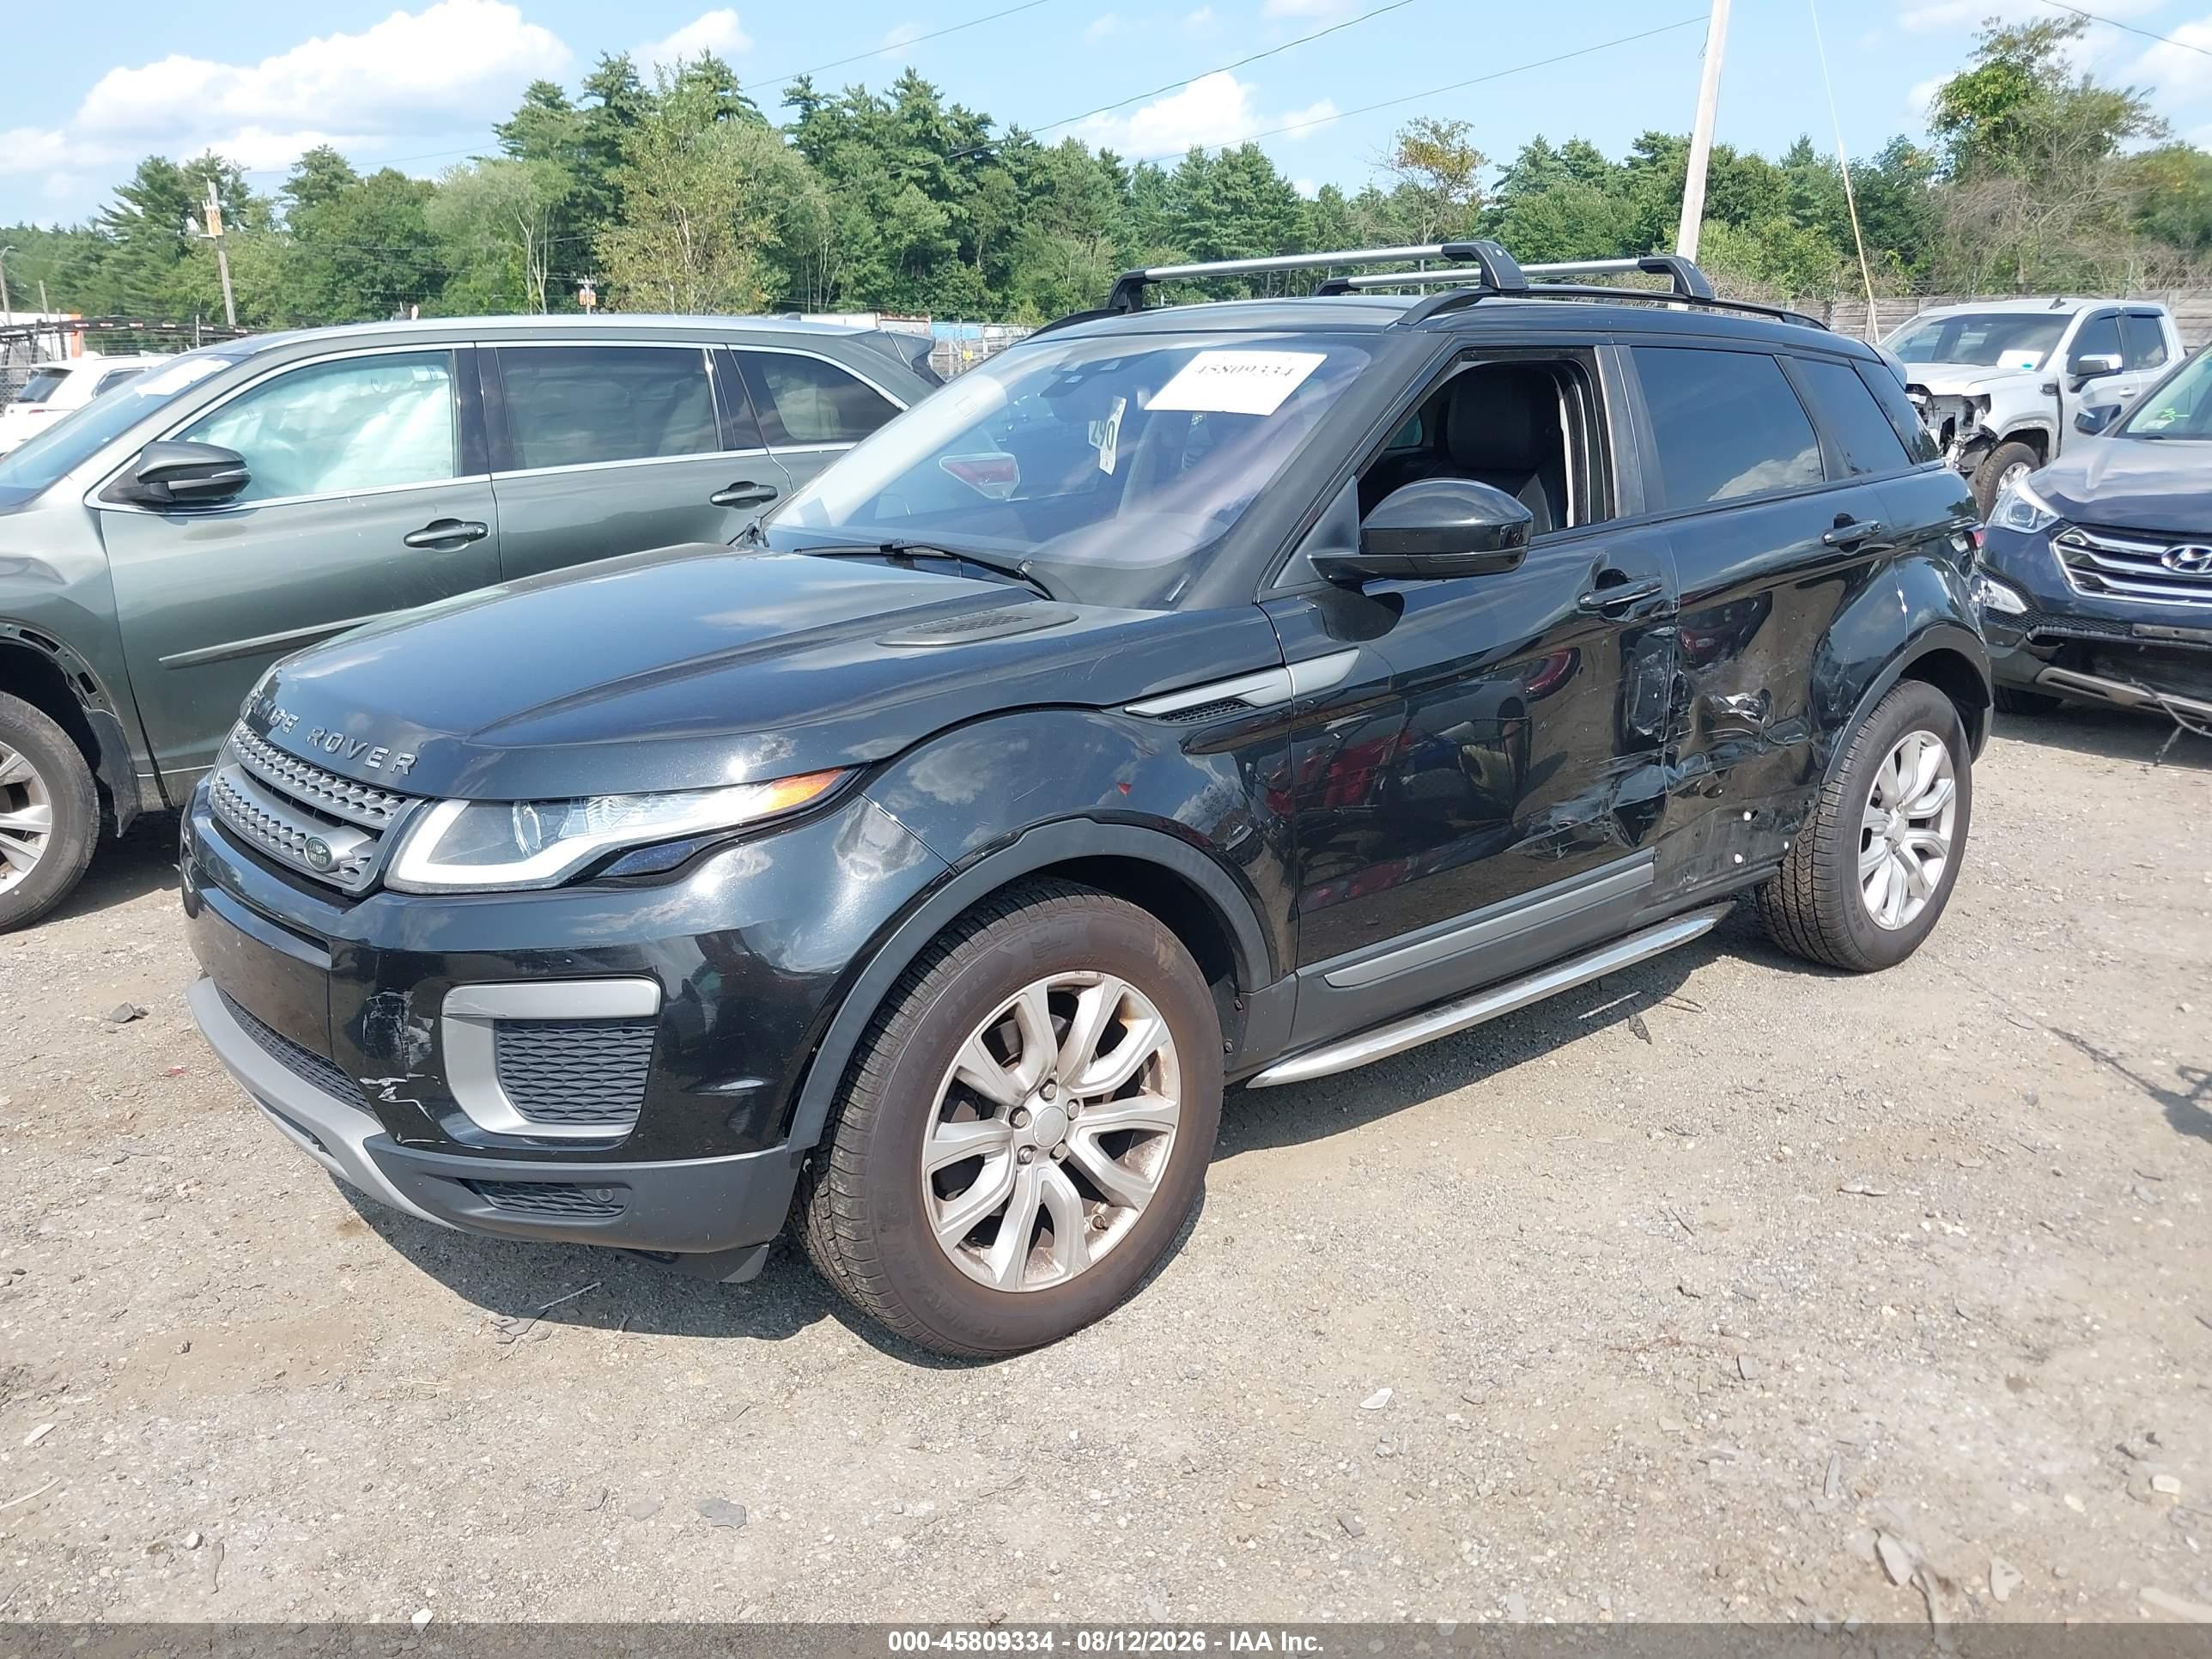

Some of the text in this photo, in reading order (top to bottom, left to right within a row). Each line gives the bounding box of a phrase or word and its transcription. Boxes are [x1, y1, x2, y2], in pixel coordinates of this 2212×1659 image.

[306, 726, 417, 775] ROVER
[308, 842, 324, 854] LAND
[310, 852, 327, 866] ROVER
